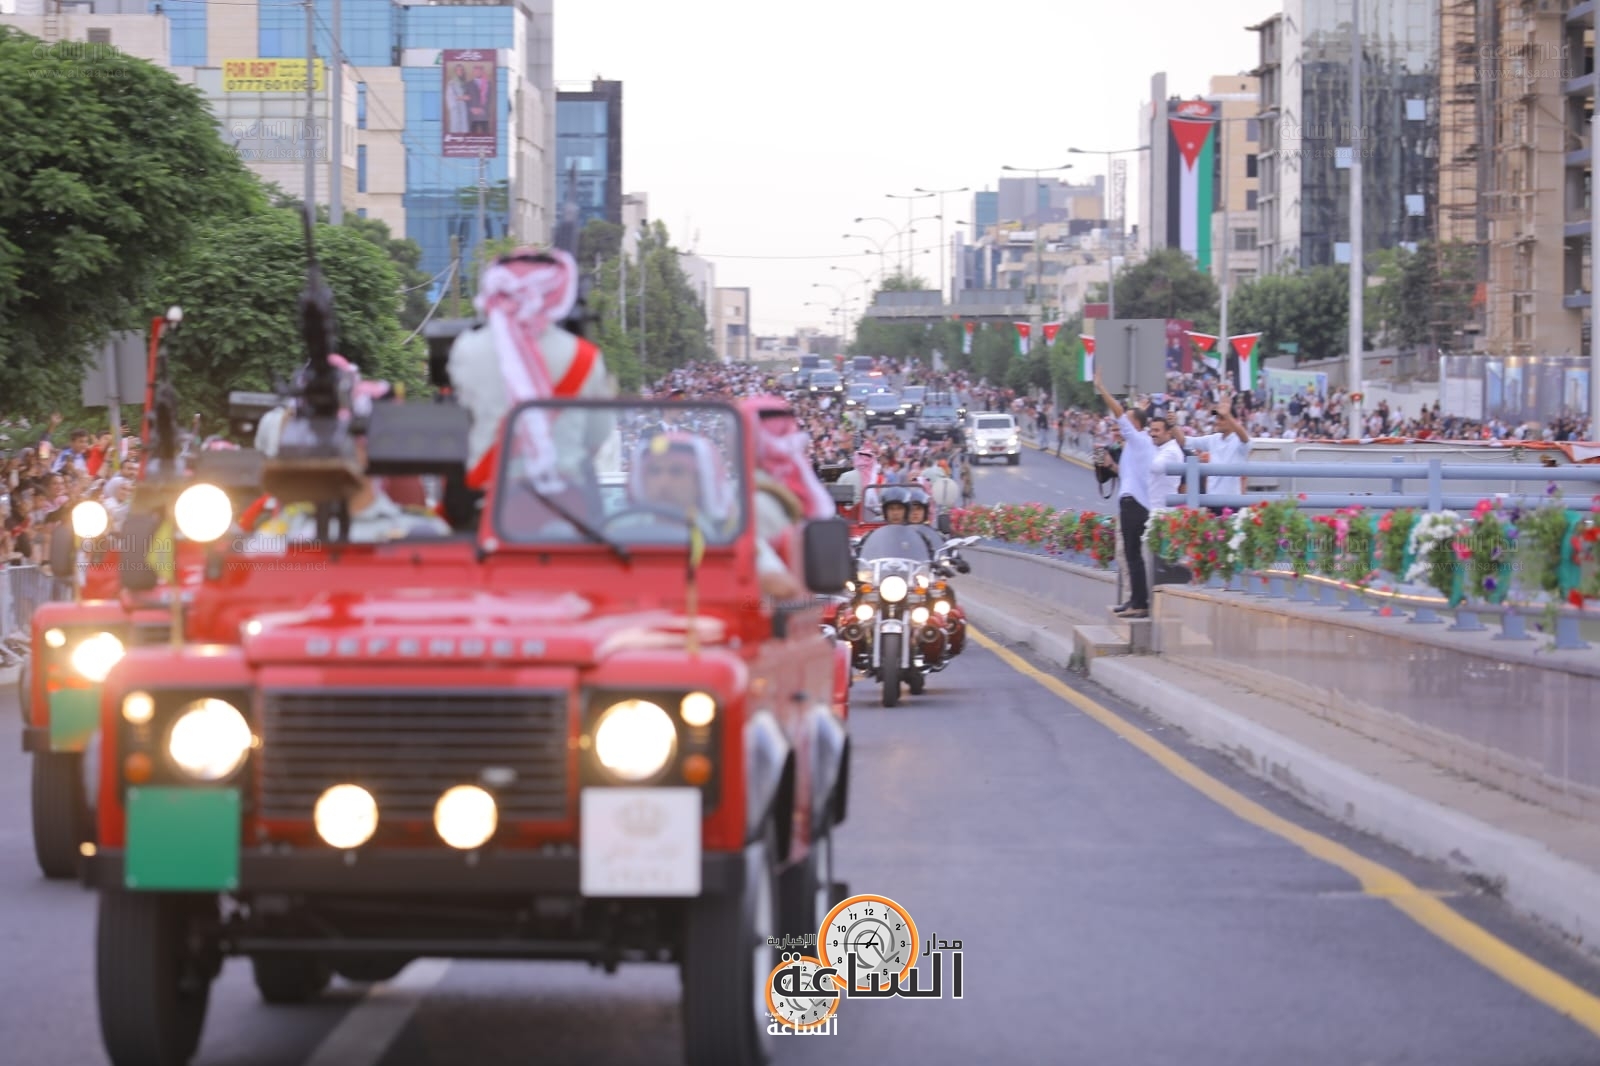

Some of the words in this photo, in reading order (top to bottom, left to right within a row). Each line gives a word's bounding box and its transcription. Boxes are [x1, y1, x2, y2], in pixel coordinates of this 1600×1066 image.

[226, 62, 246, 78] FOR
[249, 62, 277, 78] RENT
[305, 637, 546, 658] DEFENDER
